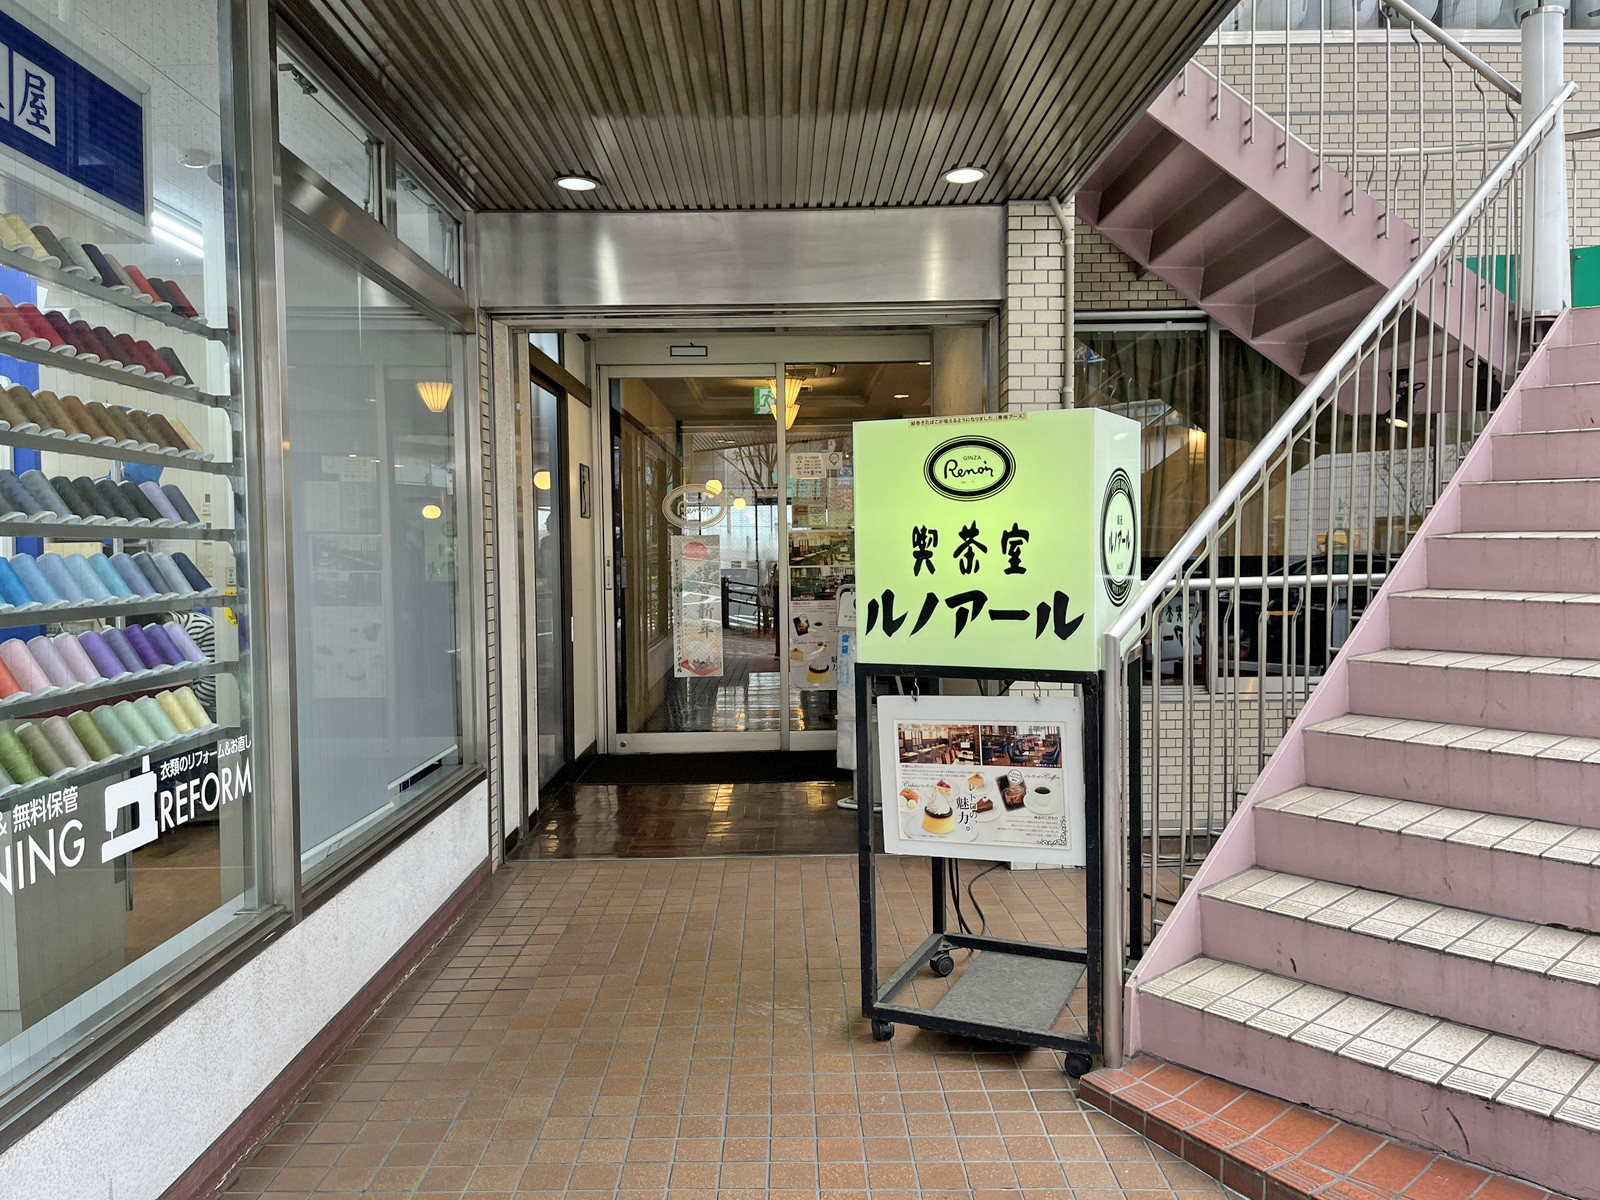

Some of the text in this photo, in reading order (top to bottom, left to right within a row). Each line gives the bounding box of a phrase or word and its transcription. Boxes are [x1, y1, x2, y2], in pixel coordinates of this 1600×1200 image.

[943, 459, 994, 479] Renoir
[912, 520, 1030, 577] 喫茶室
[865, 588, 1085, 641] ルノアール
[13, 785, 79, 834] 無料保管
[160, 760, 253, 833] REFORM
